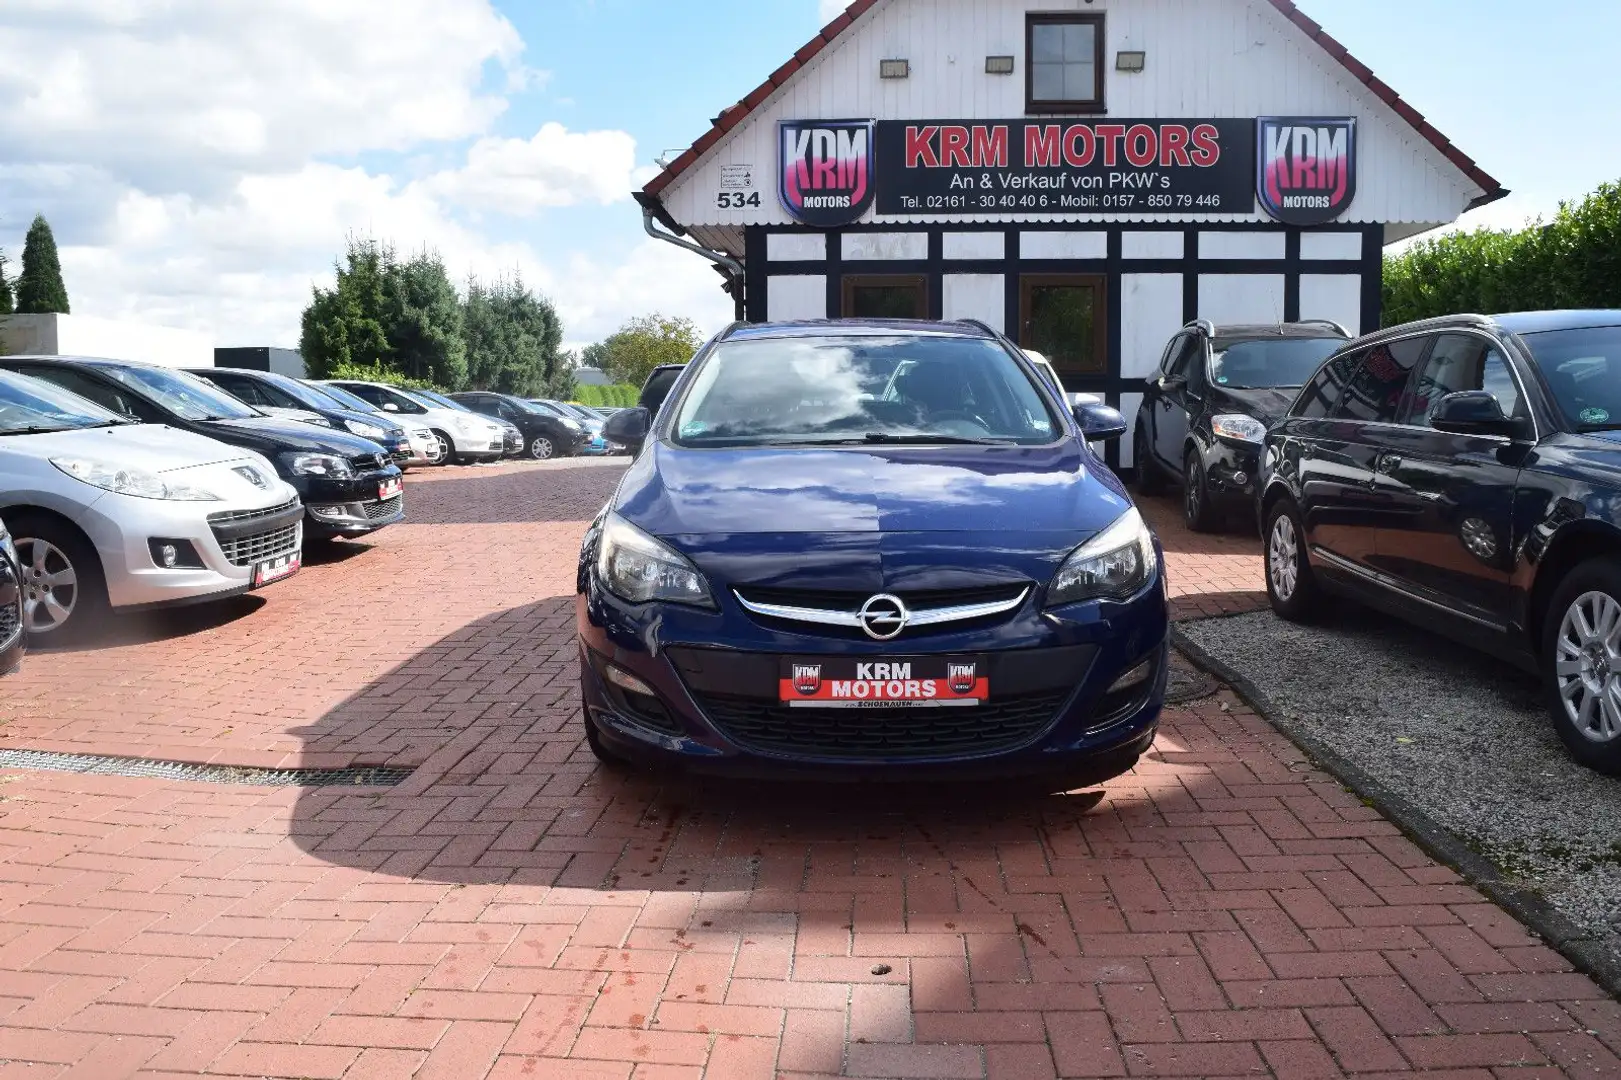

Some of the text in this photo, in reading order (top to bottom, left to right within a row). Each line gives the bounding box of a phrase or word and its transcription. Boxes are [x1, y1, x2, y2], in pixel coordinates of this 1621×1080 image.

[904, 123, 1221, 170] KRM MOTORS
[787, 129, 867, 206] KRM
[1267, 127, 1347, 207] KRM
[950, 173, 974, 189] An
[979, 173, 993, 189] &
[998, 172, 1067, 189] Verkauf
[1071, 176, 1103, 189] von
[717, 191, 760, 209] 534
[803, 195, 851, 208] MOTORS
[900, 195, 923, 208] Tel.
[926, 195, 965, 208] 02161
[980, 195, 996, 207] 30
[999, 195, 1016, 207] 40
[1019, 195, 1036, 207] 40
[1039, 195, 1048, 207] 6
[1060, 194, 1099, 207] Mobil:
[1103, 194, 1135, 207] 0157
[1147, 194, 1173, 207] 850
[1176, 194, 1193, 207] 79
[1195, 194, 1220, 207] 446
[1283, 195, 1330, 208] MOTORS
[856, 662, 911, 680] KRM
[831, 680, 937, 698] MOTORS
